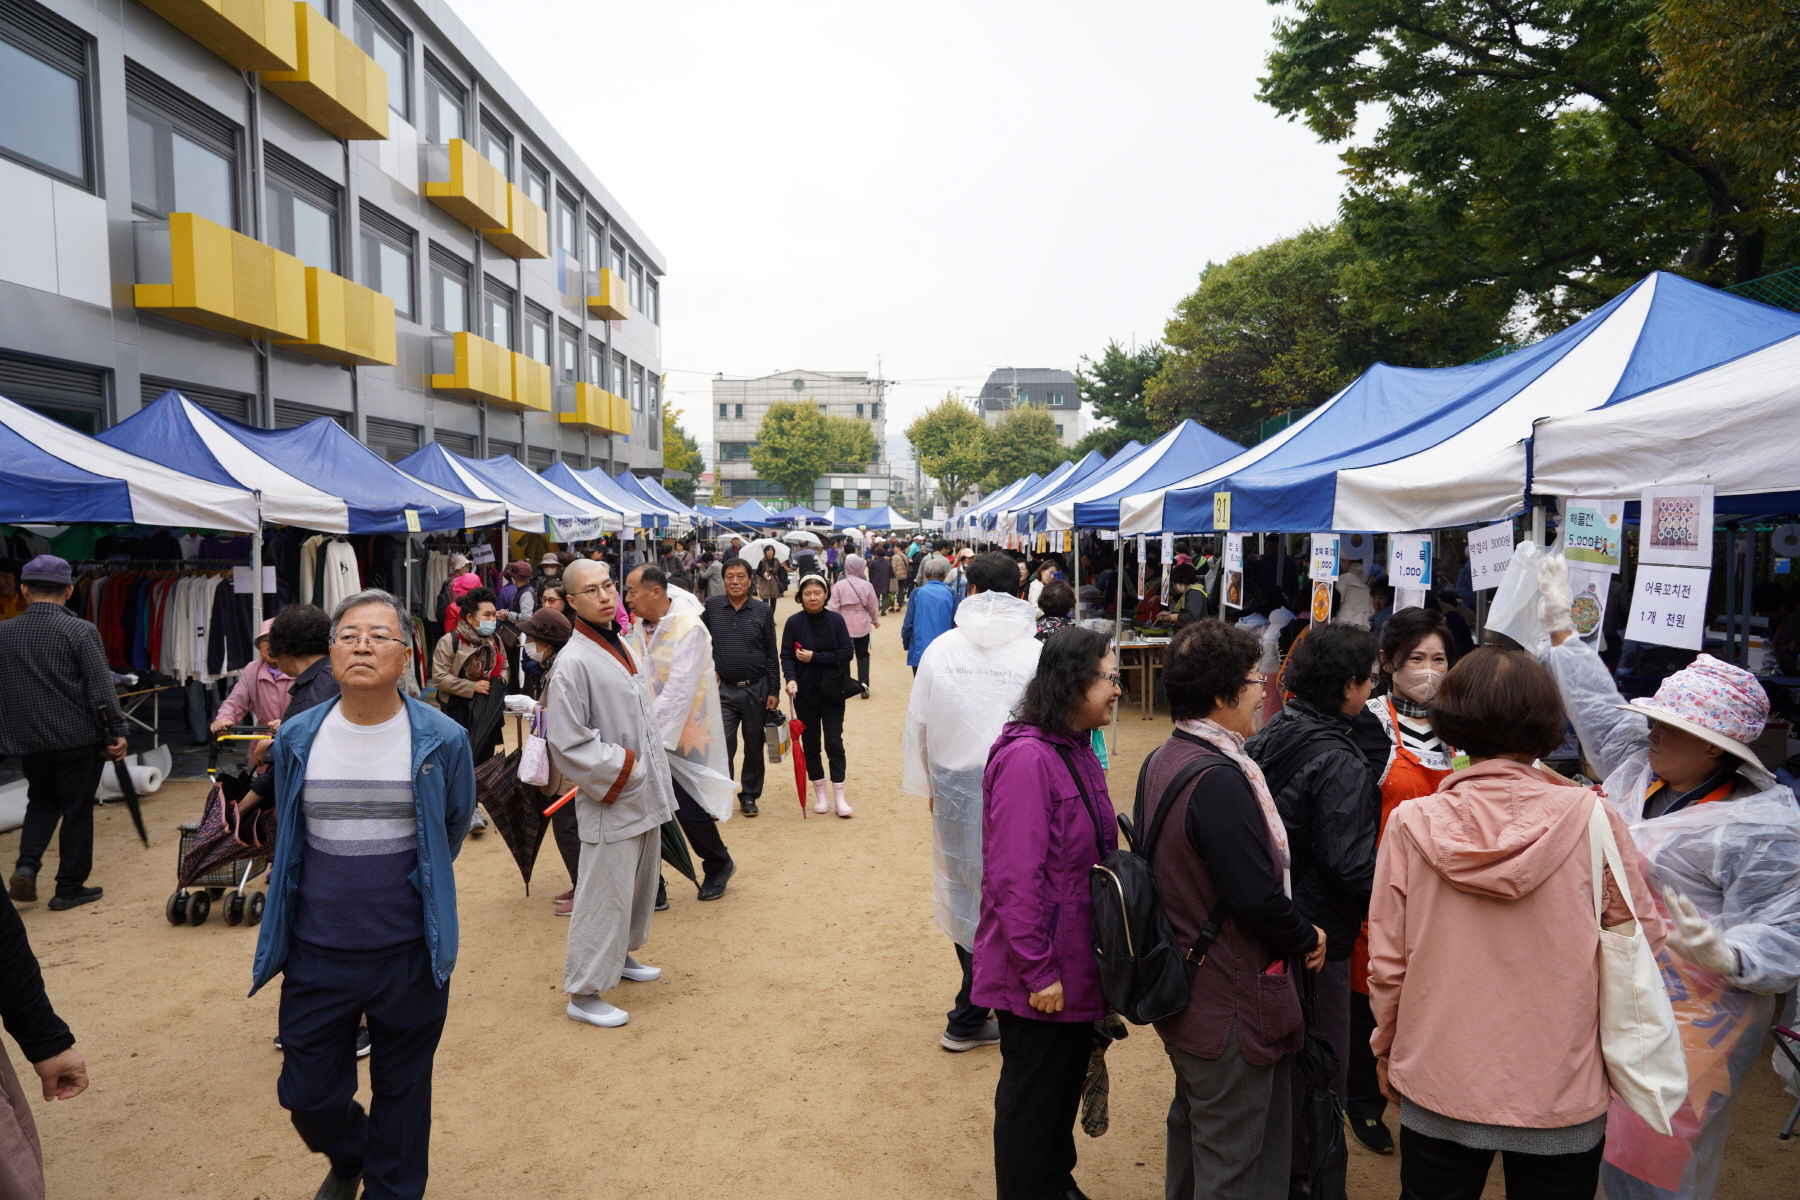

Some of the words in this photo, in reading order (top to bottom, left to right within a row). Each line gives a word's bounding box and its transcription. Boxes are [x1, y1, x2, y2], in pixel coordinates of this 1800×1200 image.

[1216, 498, 1227, 523] 31
[1569, 512, 1594, 527] 해물전
[1469, 540, 1488, 555] 막걸리
[1491, 534, 1511, 549] 3000원
[1568, 534, 1603, 550] 5,000원
[1399, 565, 1422, 577] 1,000
[1645, 581, 1692, 599] 어묵꼬치전
[1666, 612, 1686, 628] 천원
[985, 669, 1007, 677] where
